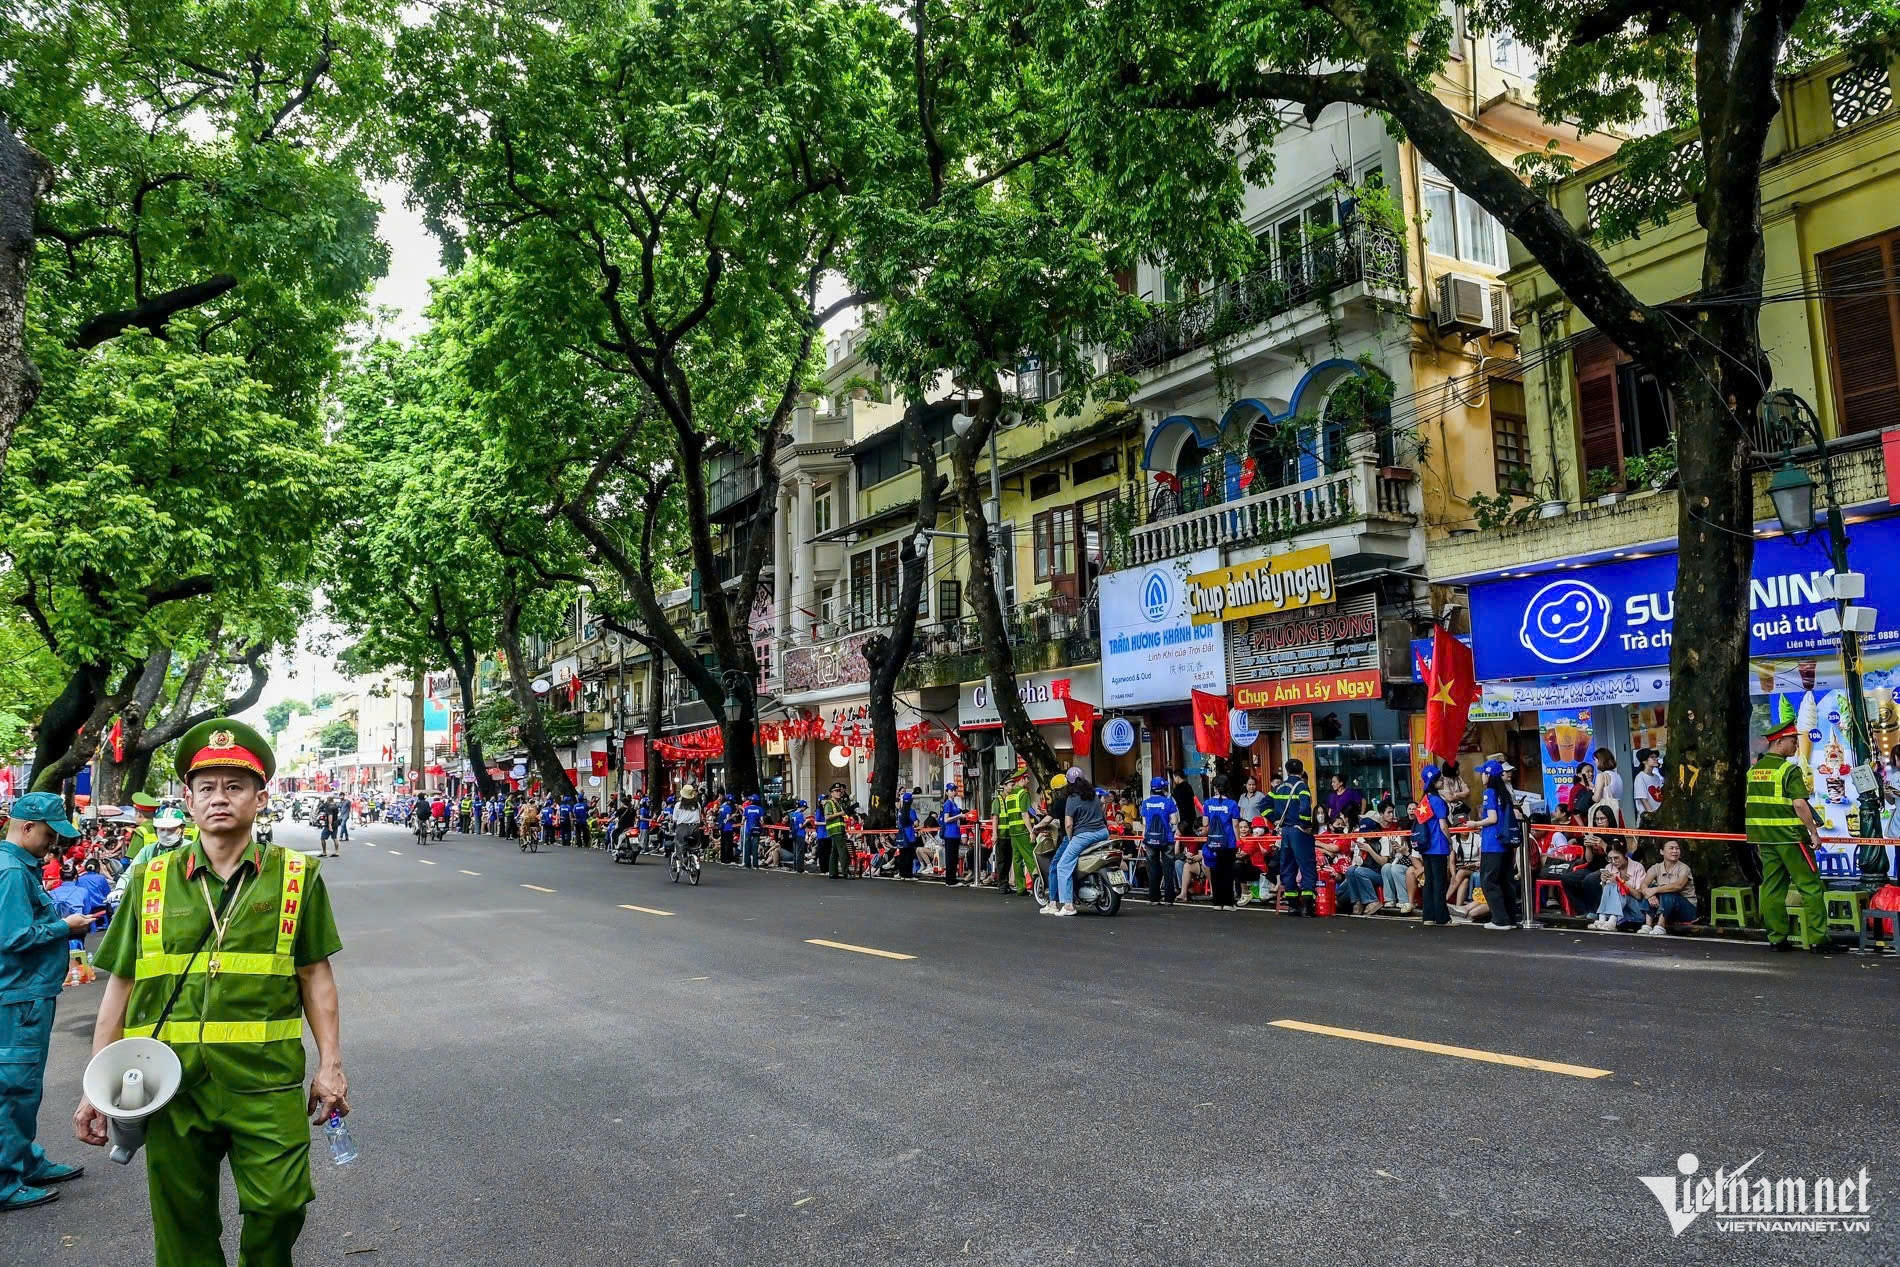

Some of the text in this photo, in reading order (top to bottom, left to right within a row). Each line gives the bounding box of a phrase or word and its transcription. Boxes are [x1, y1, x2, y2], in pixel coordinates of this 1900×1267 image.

[1188, 582, 1225, 618] Chụp
[1227, 572, 1255, 607] ảnh
[1255, 561, 1285, 608] lấy
[1284, 563, 1331, 605] ngay
[1625, 568, 1836, 626] SU NIN
[1150, 606, 1164, 616] ATC
[1620, 630, 1649, 650] Trà
[1652, 628, 1672, 648] ch
[1752, 614, 1791, 641] quả
[1238, 689, 1268, 707] Chụp
[1306, 680, 1331, 700] Lấy
[1337, 679, 1375, 698] Ngay
[1808, 732, 1822, 740] 10k
[858, 755, 865, 764] 23
[1680, 764, 1700, 787] 17
[871, 795, 880, 808] 13
[145, 860, 163, 935] CAHN
[281, 860, 302, 935] CAHN
